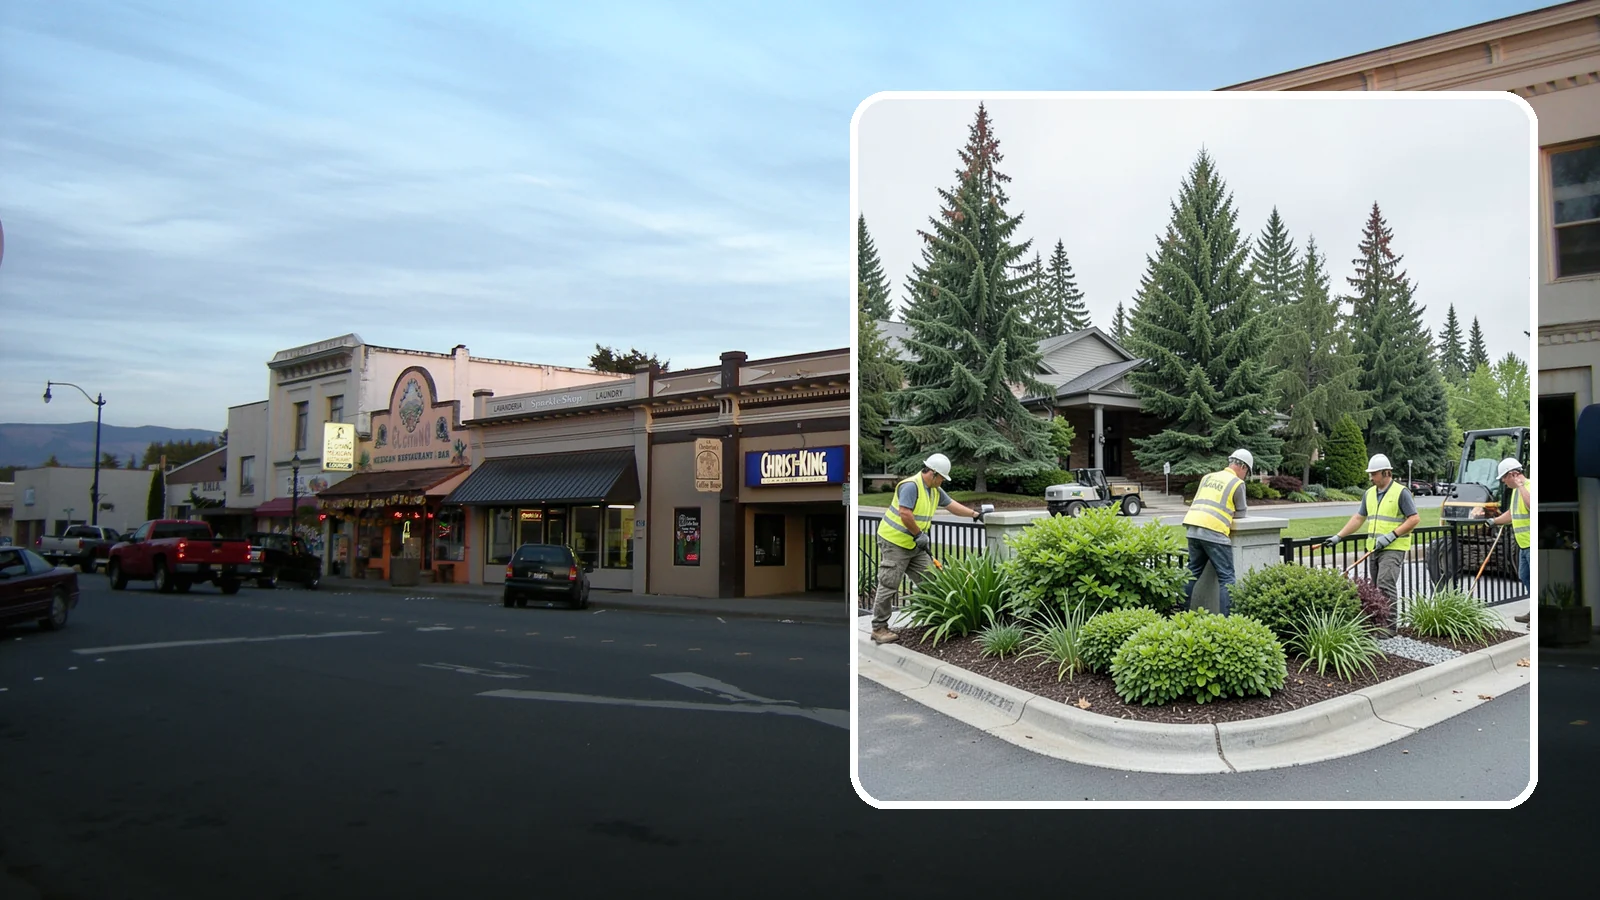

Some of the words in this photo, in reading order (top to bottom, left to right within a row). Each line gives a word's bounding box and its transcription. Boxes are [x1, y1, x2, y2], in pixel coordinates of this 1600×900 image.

[493, 402, 522, 412] LAVANDERIA
[531, 396, 561, 410] Sparkle
[561, 394, 582, 405] Shop
[596, 389, 624, 400] LAUNDRY
[373, 455, 396, 464] MEXICAN
[397, 452, 433, 462] RESTAURANT
[438, 450, 450, 459] BAR
[761, 452, 797, 478] CHRIST
[799, 450, 827, 477] KING
